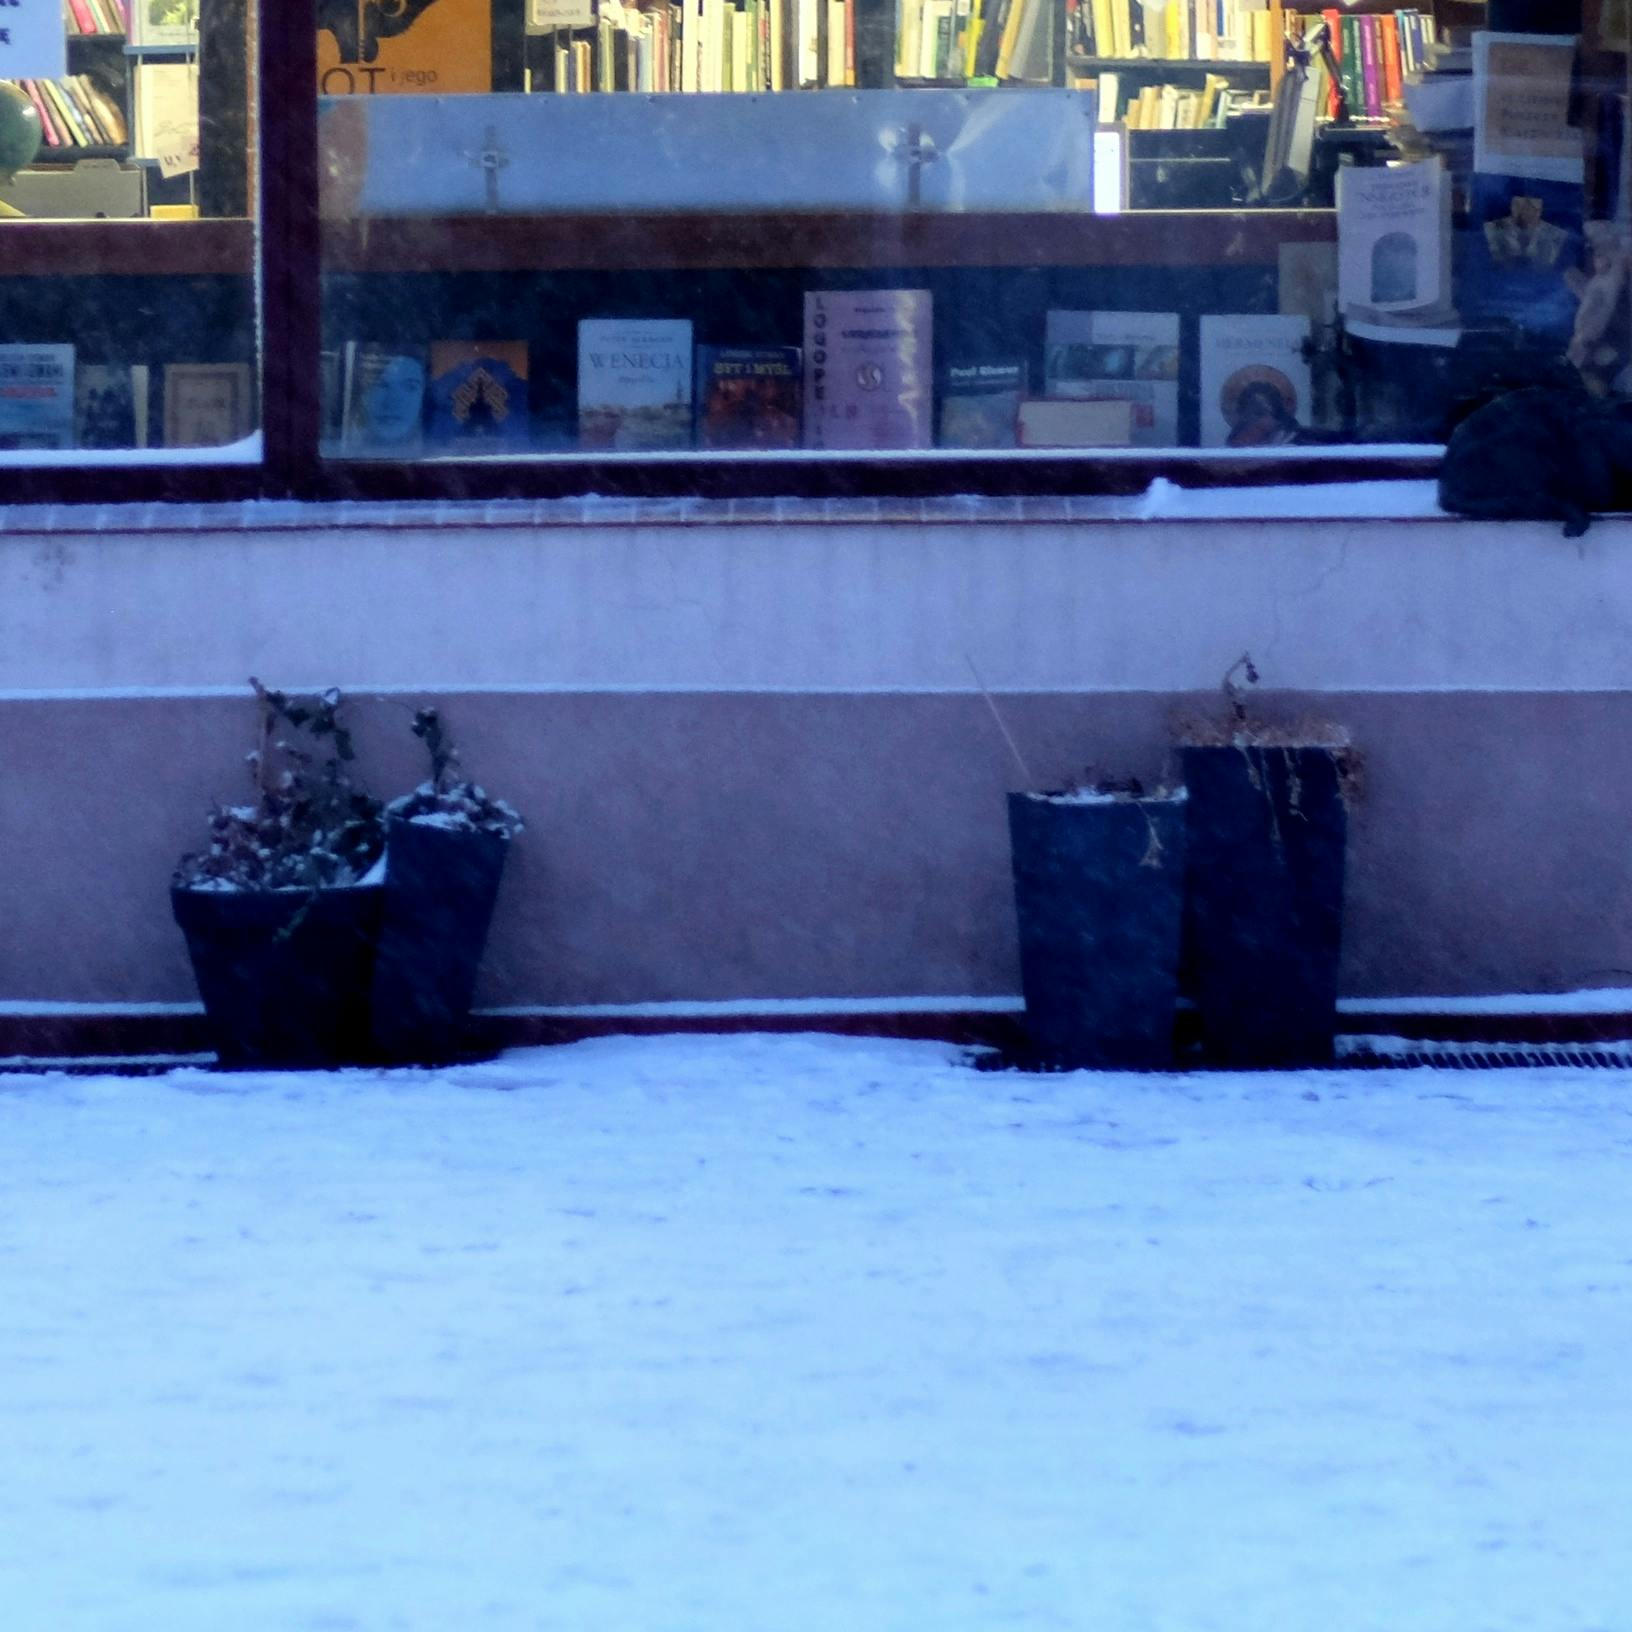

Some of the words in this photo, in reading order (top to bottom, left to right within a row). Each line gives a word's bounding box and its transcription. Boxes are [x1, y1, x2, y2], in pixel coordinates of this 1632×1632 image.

[320, 67, 386, 94] OT
[399, 69, 438, 86] jego
[589, 352, 686, 369] WENECJA
